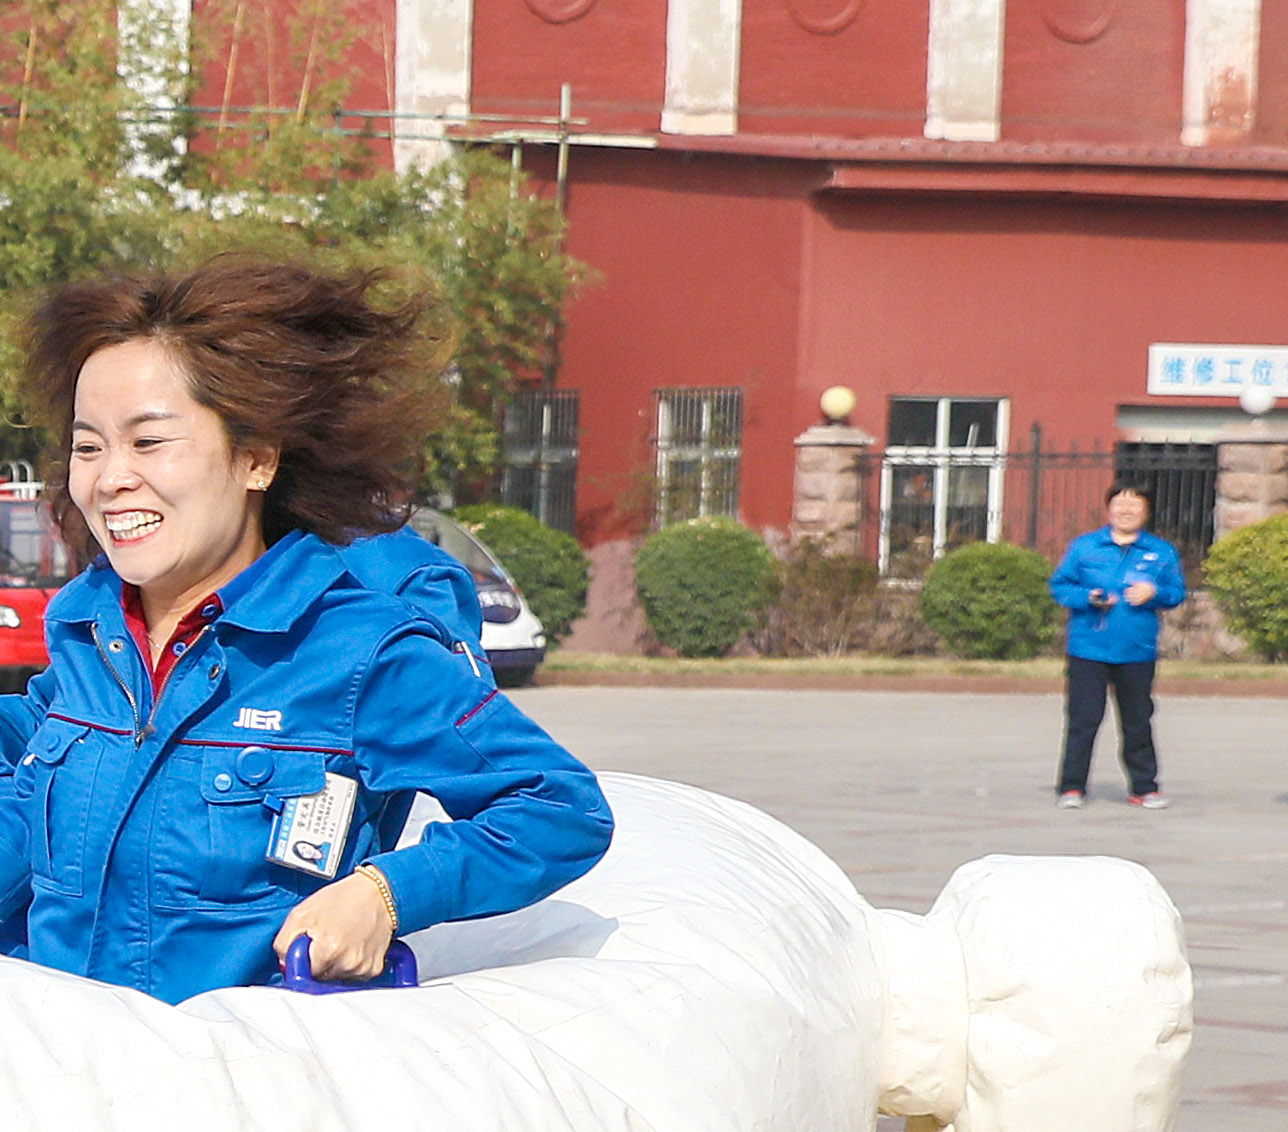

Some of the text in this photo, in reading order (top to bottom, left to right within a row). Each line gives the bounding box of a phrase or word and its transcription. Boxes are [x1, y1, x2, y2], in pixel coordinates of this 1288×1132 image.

[1160, 356, 1288, 386] 维修工位
[232, 707, 283, 732] JIER
